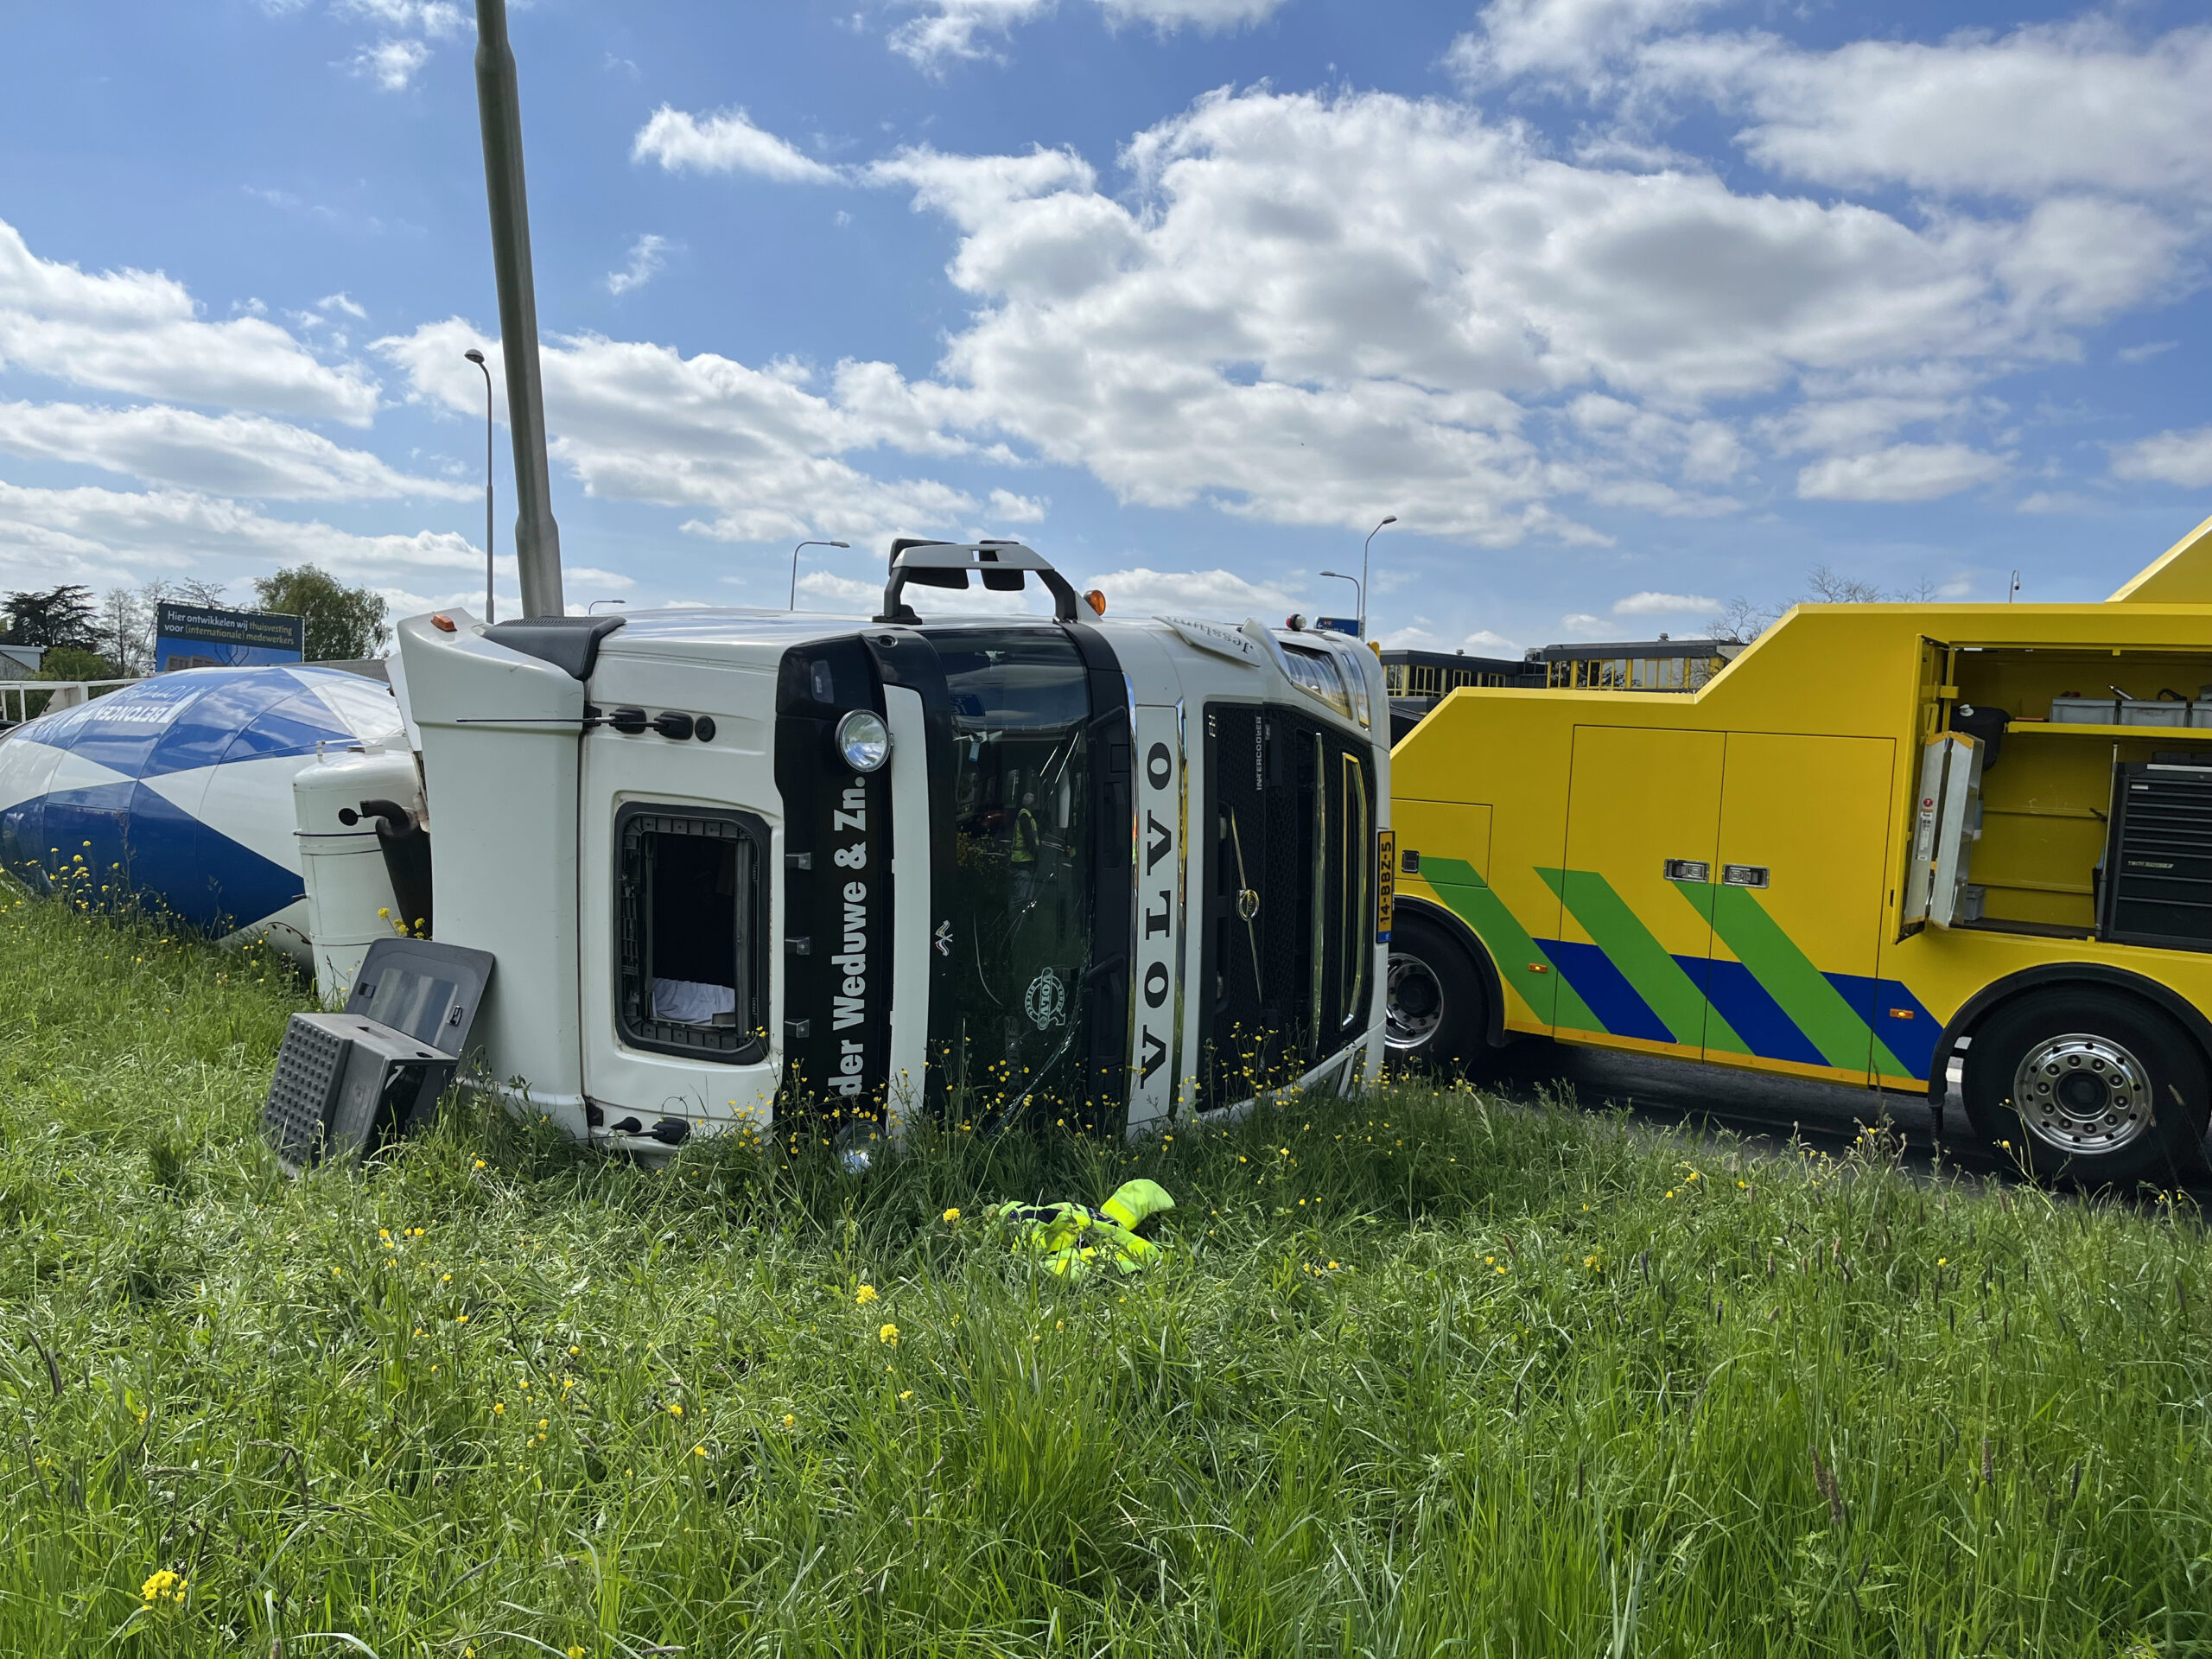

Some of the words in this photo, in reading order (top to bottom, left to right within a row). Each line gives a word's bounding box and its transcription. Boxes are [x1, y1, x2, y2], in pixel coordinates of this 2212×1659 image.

[164, 624, 184, 632] voor
[185, 624, 245, 640] (internationale)
[246, 633, 295, 645] medewerkers
[168, 610, 185, 621] Hier
[187, 615, 235, 628] ontwikkelen
[237, 620, 248, 631] wij
[249, 621, 293, 636] thuisvesting
[1208, 715, 1217, 737] FH
[834, 777, 866, 831] Zn.
[834, 842, 868, 869] &
[1380, 842, 1392, 923] 14-BBZ-5
[1140, 741, 1173, 1090] VOLVO
[831, 881, 868, 1031] Weduwe
[1039, 973, 1052, 1028] VOLVO
[828, 1039, 864, 1096] der
